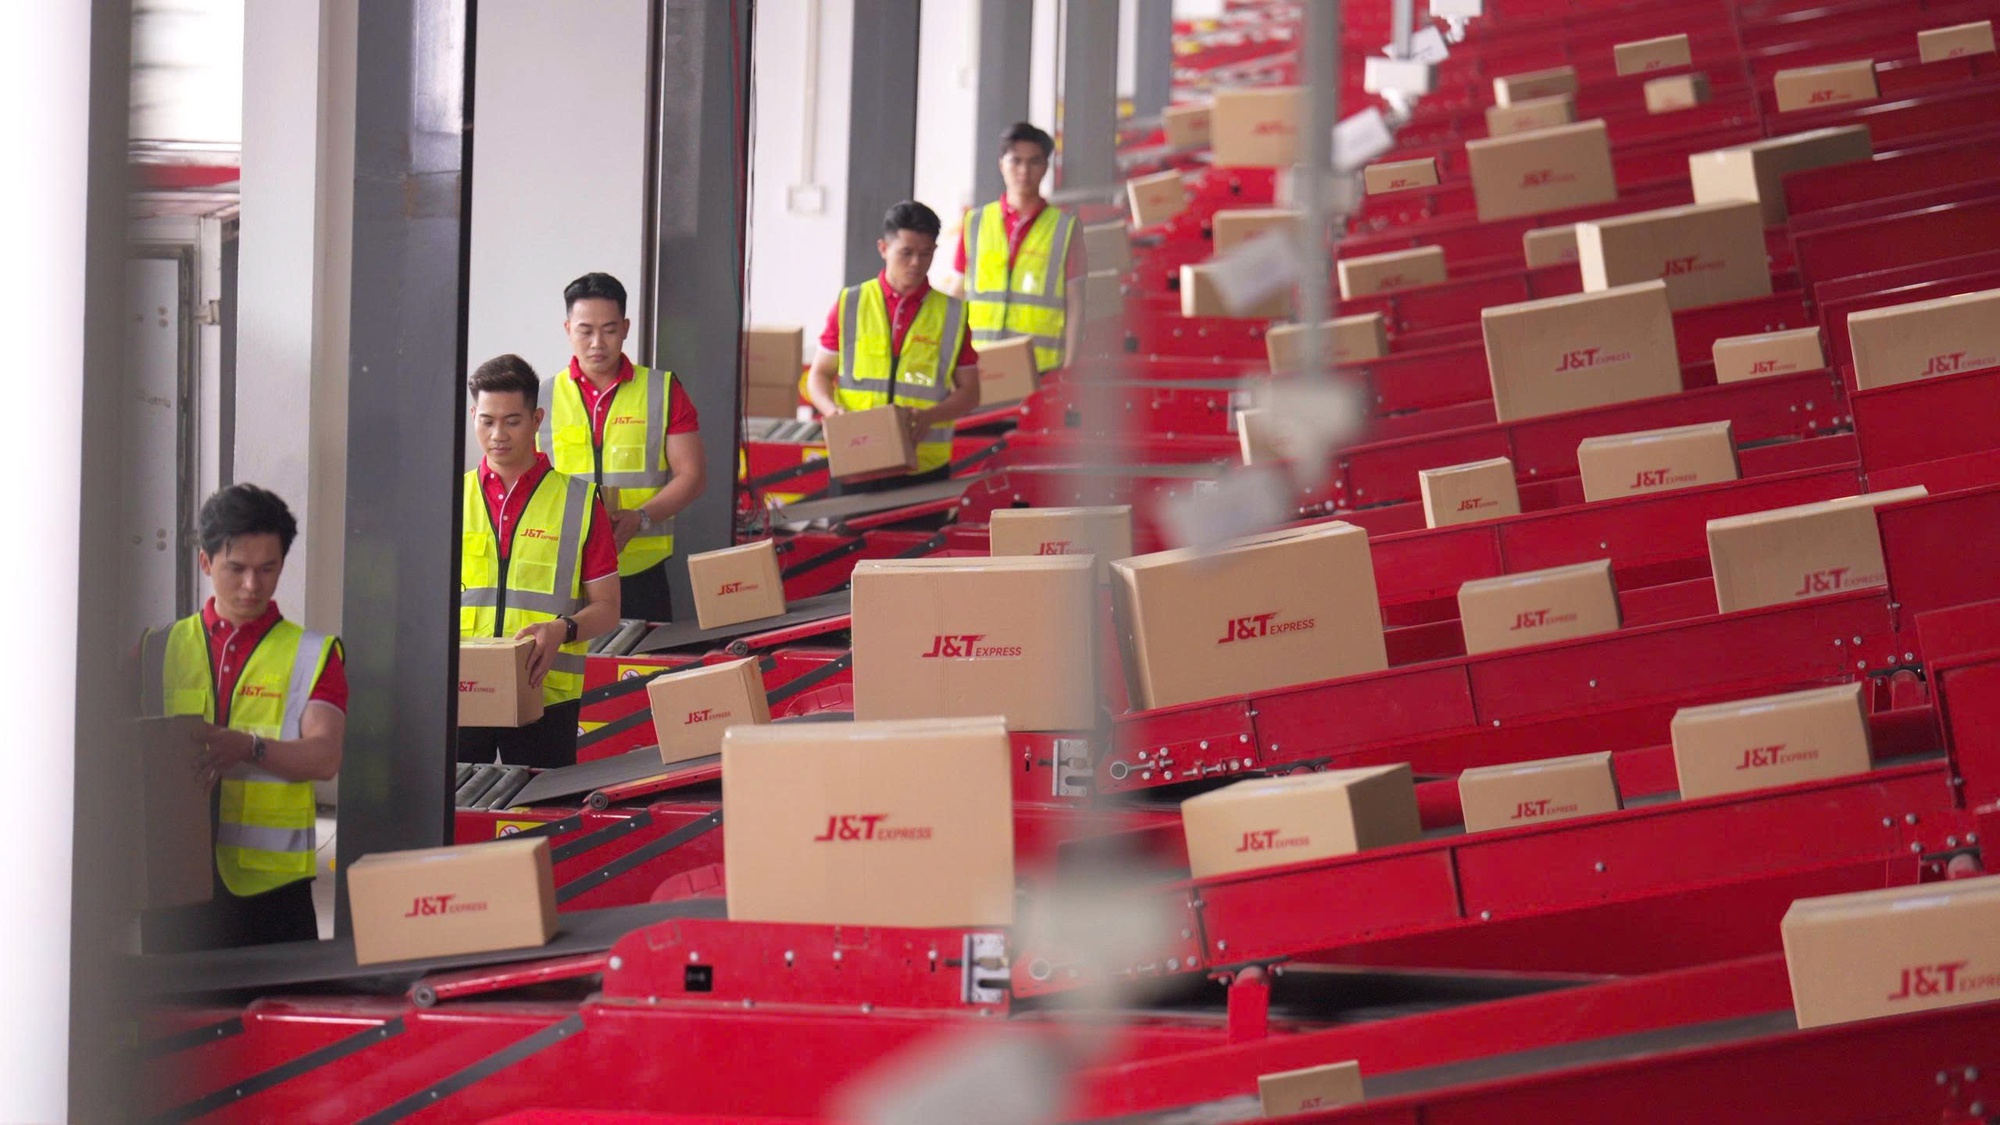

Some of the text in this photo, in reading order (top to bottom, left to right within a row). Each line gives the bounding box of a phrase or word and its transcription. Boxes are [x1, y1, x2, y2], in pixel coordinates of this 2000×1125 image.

[1658, 255, 1698, 279] J&T
[1555, 348, 1632, 373] J&T EXPRESS
[1749, 360, 1778, 375] J&T
[1922, 350, 1968, 376] J&T
[612, 416, 633, 425] J&T
[1630, 468, 1697, 488] J&T EXPRESS
[1457, 498, 1482, 512] J&T
[520, 528, 545, 538] J&T
[1033, 540, 1072, 556] J&T
[717, 581, 744, 596] J&T
[1795, 566, 1850, 596] J&T
[1217, 608, 1315, 644] J&T EXPRESS
[1509, 608, 1578, 630] J&T EXPRESS
[922, 634, 1022, 658] J&T EXPRESS
[459, 681, 478, 692] &T
[684, 708, 731, 724] J&T EXPRESS
[1735, 744, 1820, 770] J&T EXPRESS
[1510, 798, 1578, 820] J&T EXPRESS
[814, 814, 932, 842] J&T EXPRESS
[1235, 829, 1310, 854] J&T EXPRESS
[404, 894, 488, 918] J&T EXPRESS
[1887, 959, 1970, 1002] J&T
